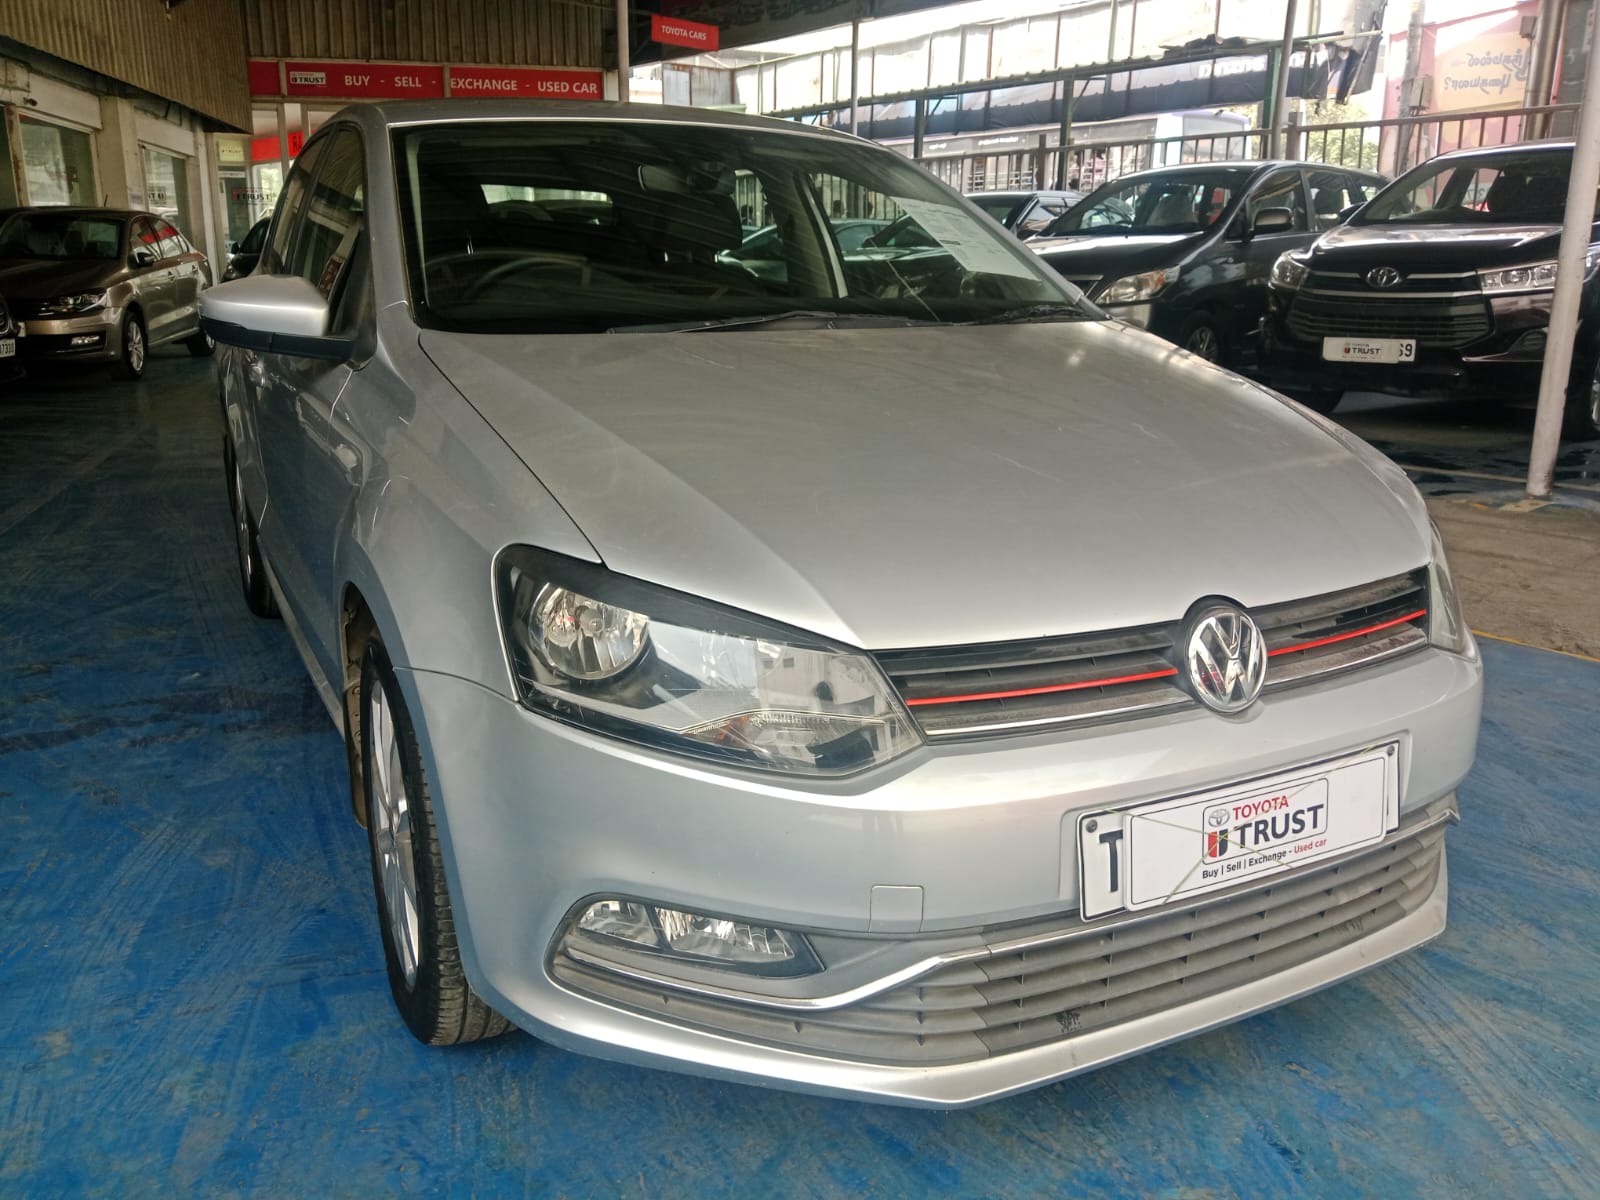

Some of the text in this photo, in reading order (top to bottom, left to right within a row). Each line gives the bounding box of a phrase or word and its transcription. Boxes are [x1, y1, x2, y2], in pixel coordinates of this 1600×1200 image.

[661, 25, 707, 41] TOYOTA CARS
[299, 76, 325, 84] TRUST
[344, 75, 598, 94] BUY SELL EXCHANGE USED CAR
[1352, 347, 1381, 355] TRUST
[1232, 795, 1289, 821] TOYOTA
[1233, 803, 1325, 850] TRUST
[1202, 839, 1327, 880] Buy Sell Exchange Used car
